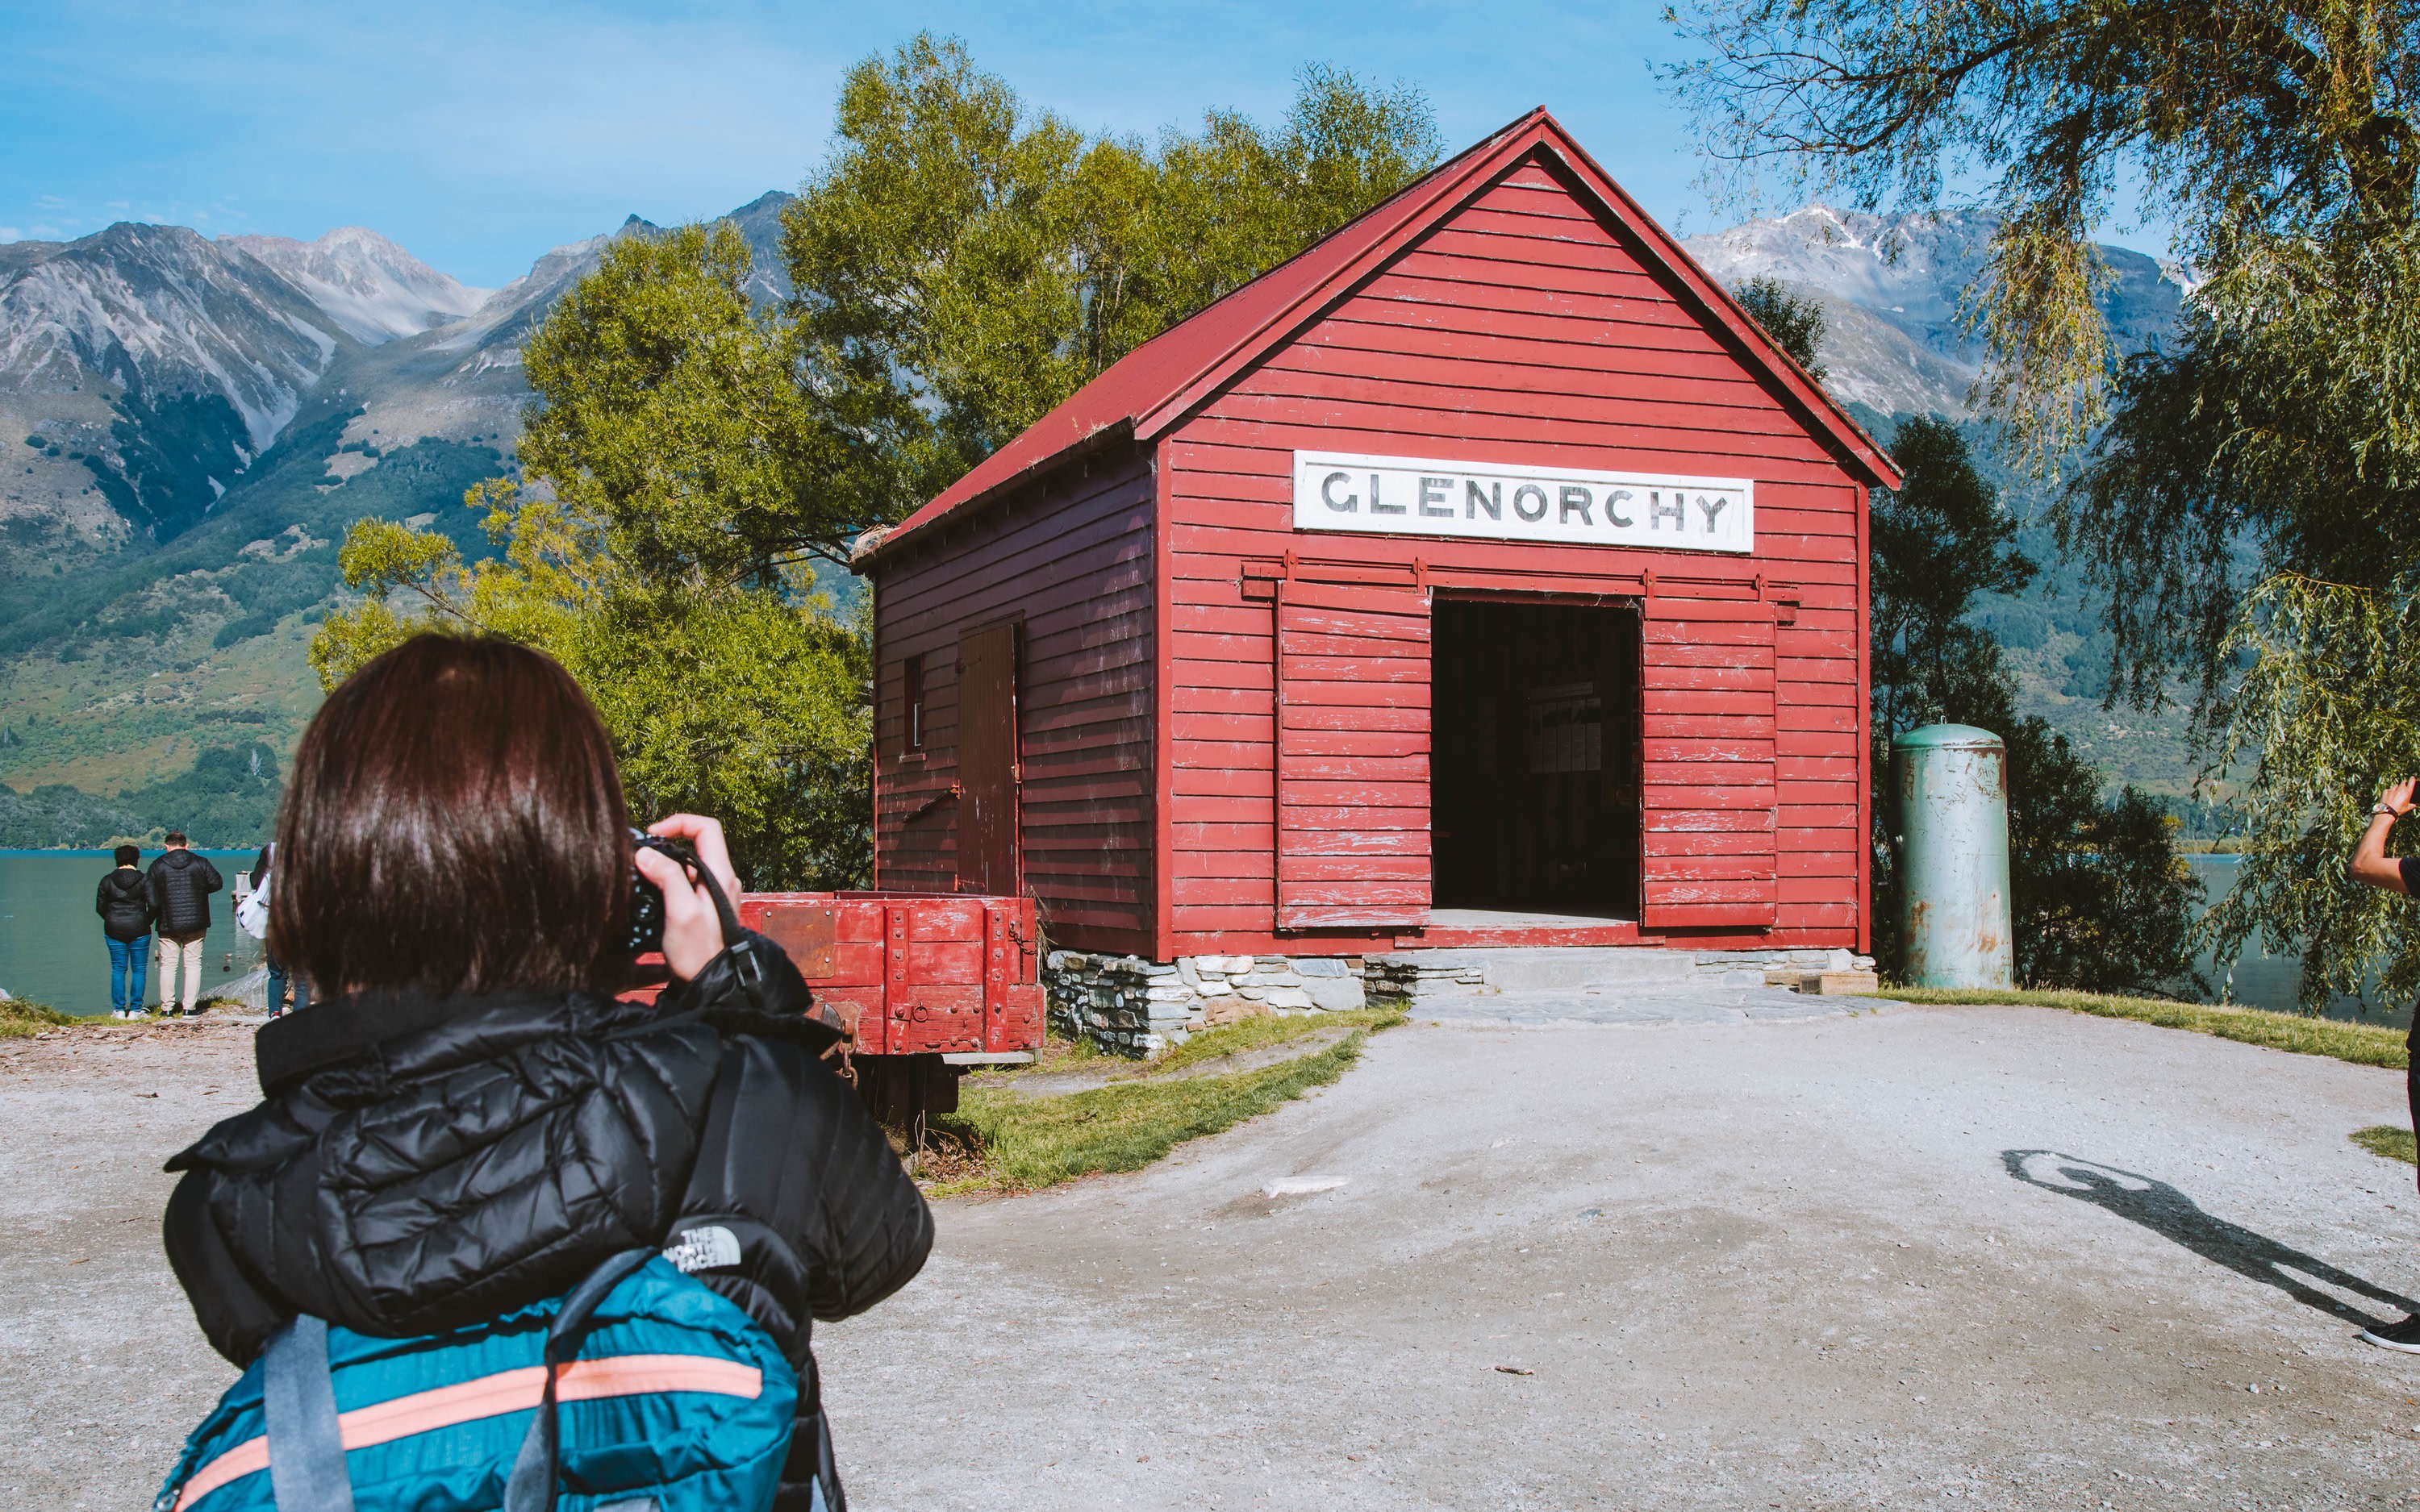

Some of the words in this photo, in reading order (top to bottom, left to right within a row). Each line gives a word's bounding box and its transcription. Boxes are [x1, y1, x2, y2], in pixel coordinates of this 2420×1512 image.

[1321, 471, 1728, 534] GLENORCHY
[681, 1227, 713, 1244] THE
[662, 1242, 716, 1264] NORTH
[678, 1254, 718, 1273] FACE
